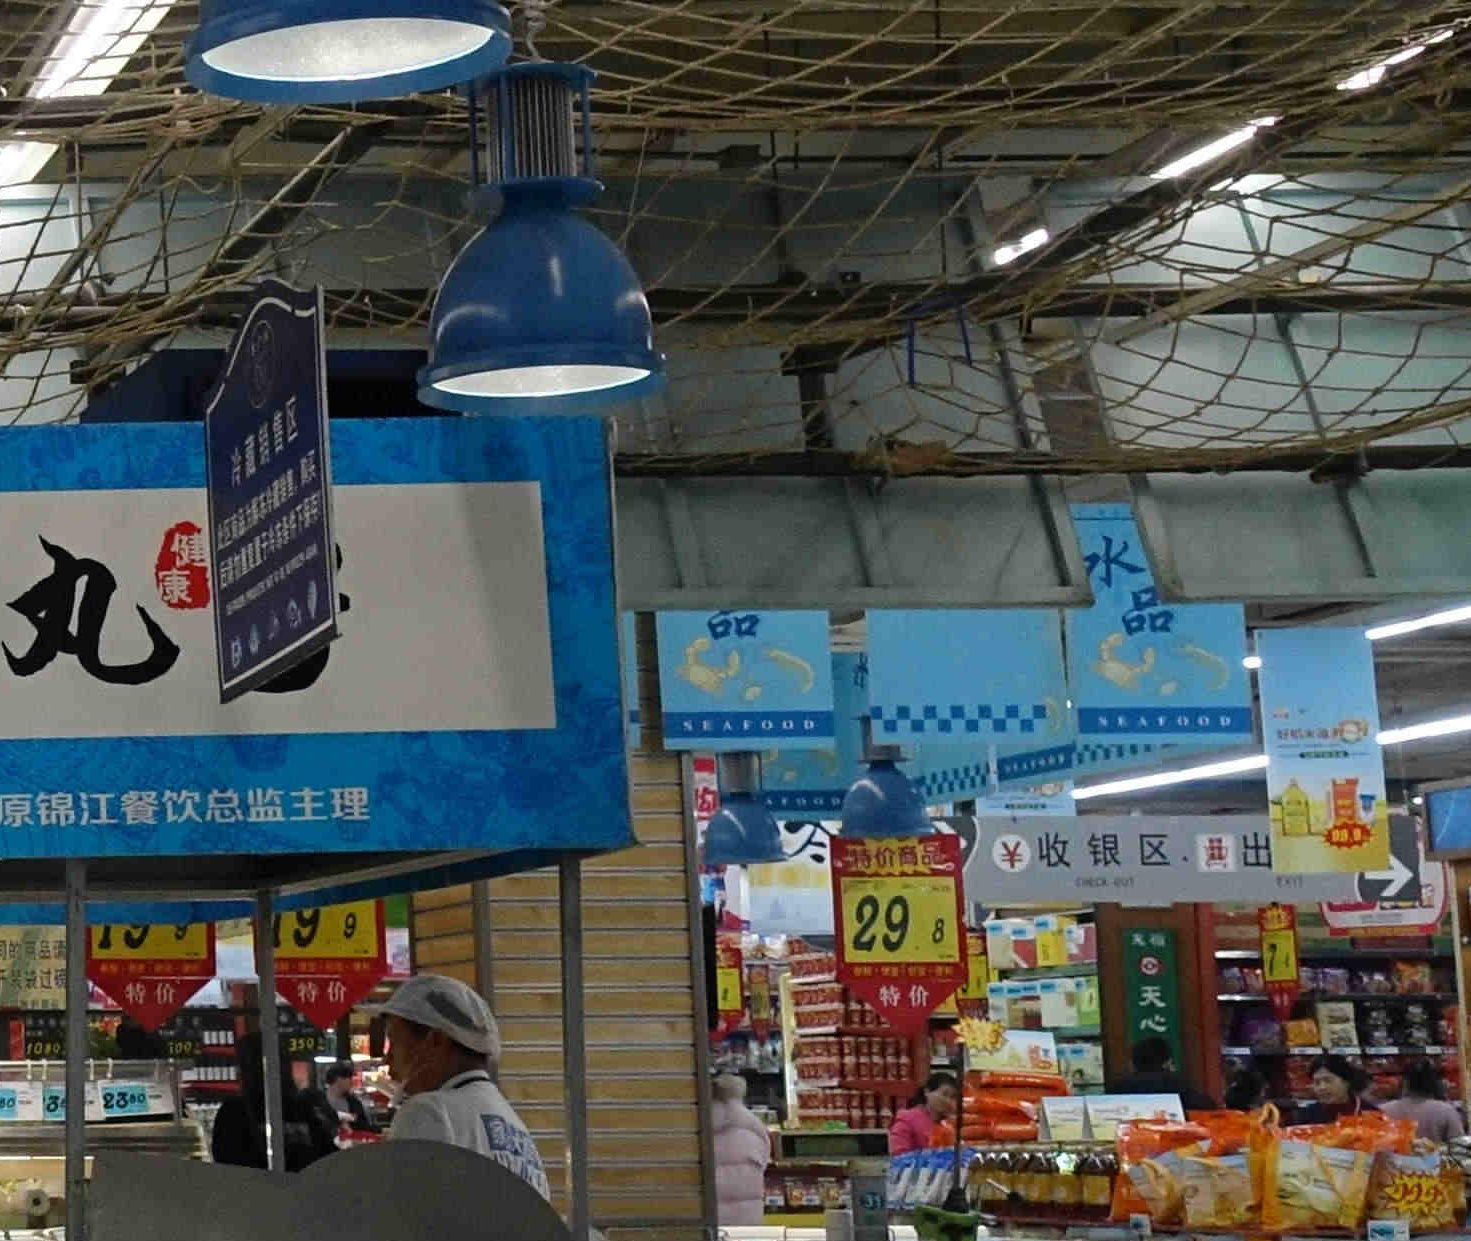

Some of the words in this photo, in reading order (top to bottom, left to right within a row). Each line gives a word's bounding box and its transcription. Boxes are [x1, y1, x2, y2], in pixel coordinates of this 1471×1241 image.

[683, 719, 818, 731] SEAFOOD
[1098, 715, 1231, 727] SEAFOOD
[1038, 833, 1171, 869] 收银区
[125, 982, 176, 1004] 特价
[297, 981, 346, 1004] 特价
[879, 985, 930, 1007] 特价
